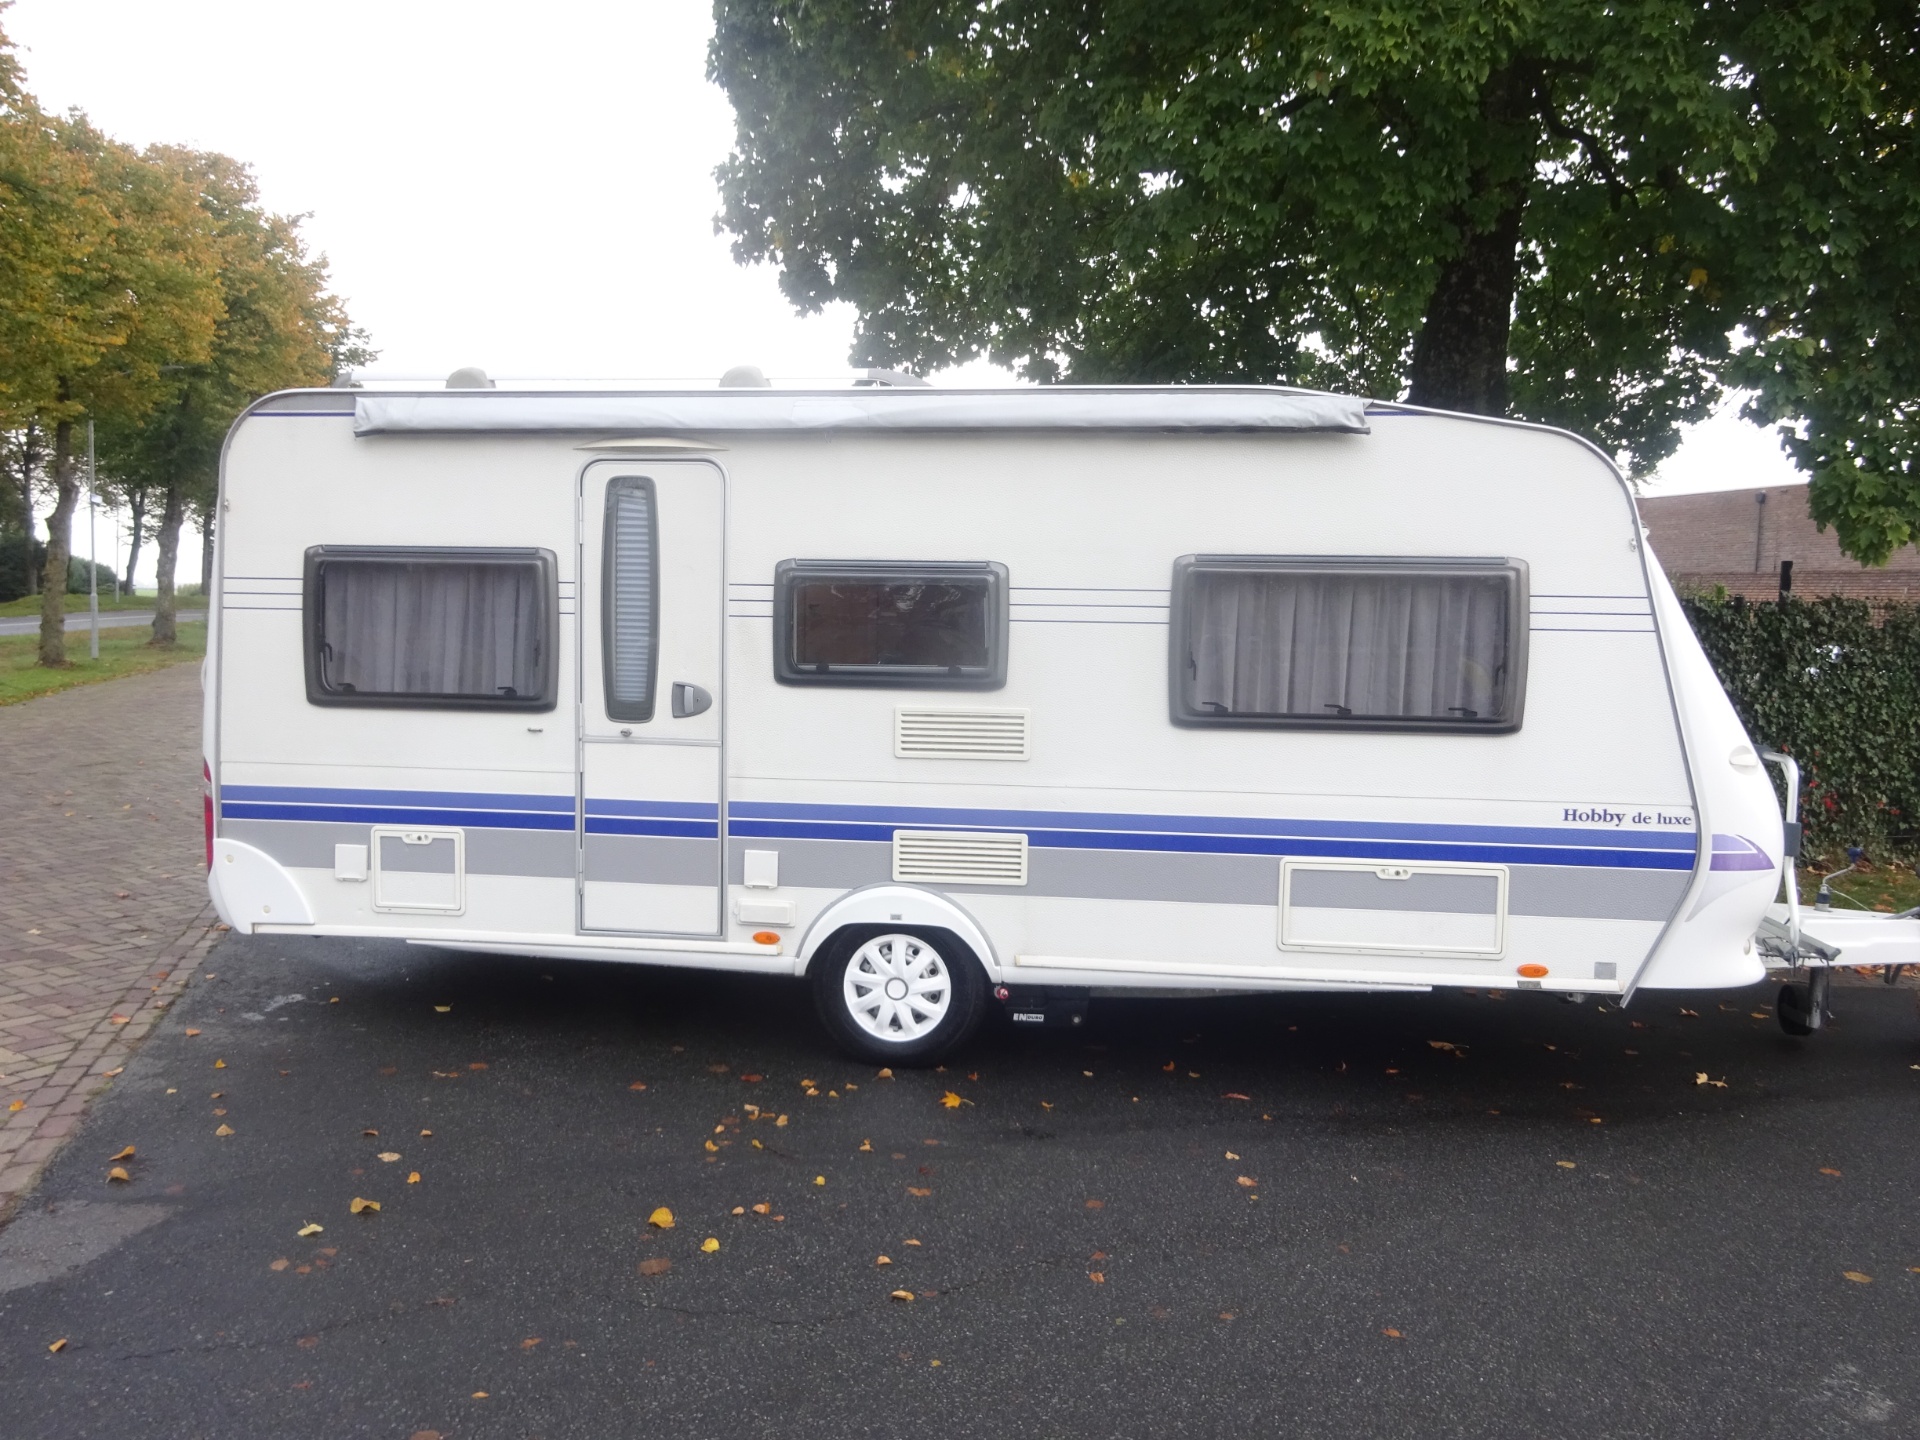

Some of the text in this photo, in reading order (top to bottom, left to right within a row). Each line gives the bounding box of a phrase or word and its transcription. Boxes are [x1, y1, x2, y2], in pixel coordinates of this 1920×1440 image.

[1563, 808, 1692, 827] Hobby de luxe
